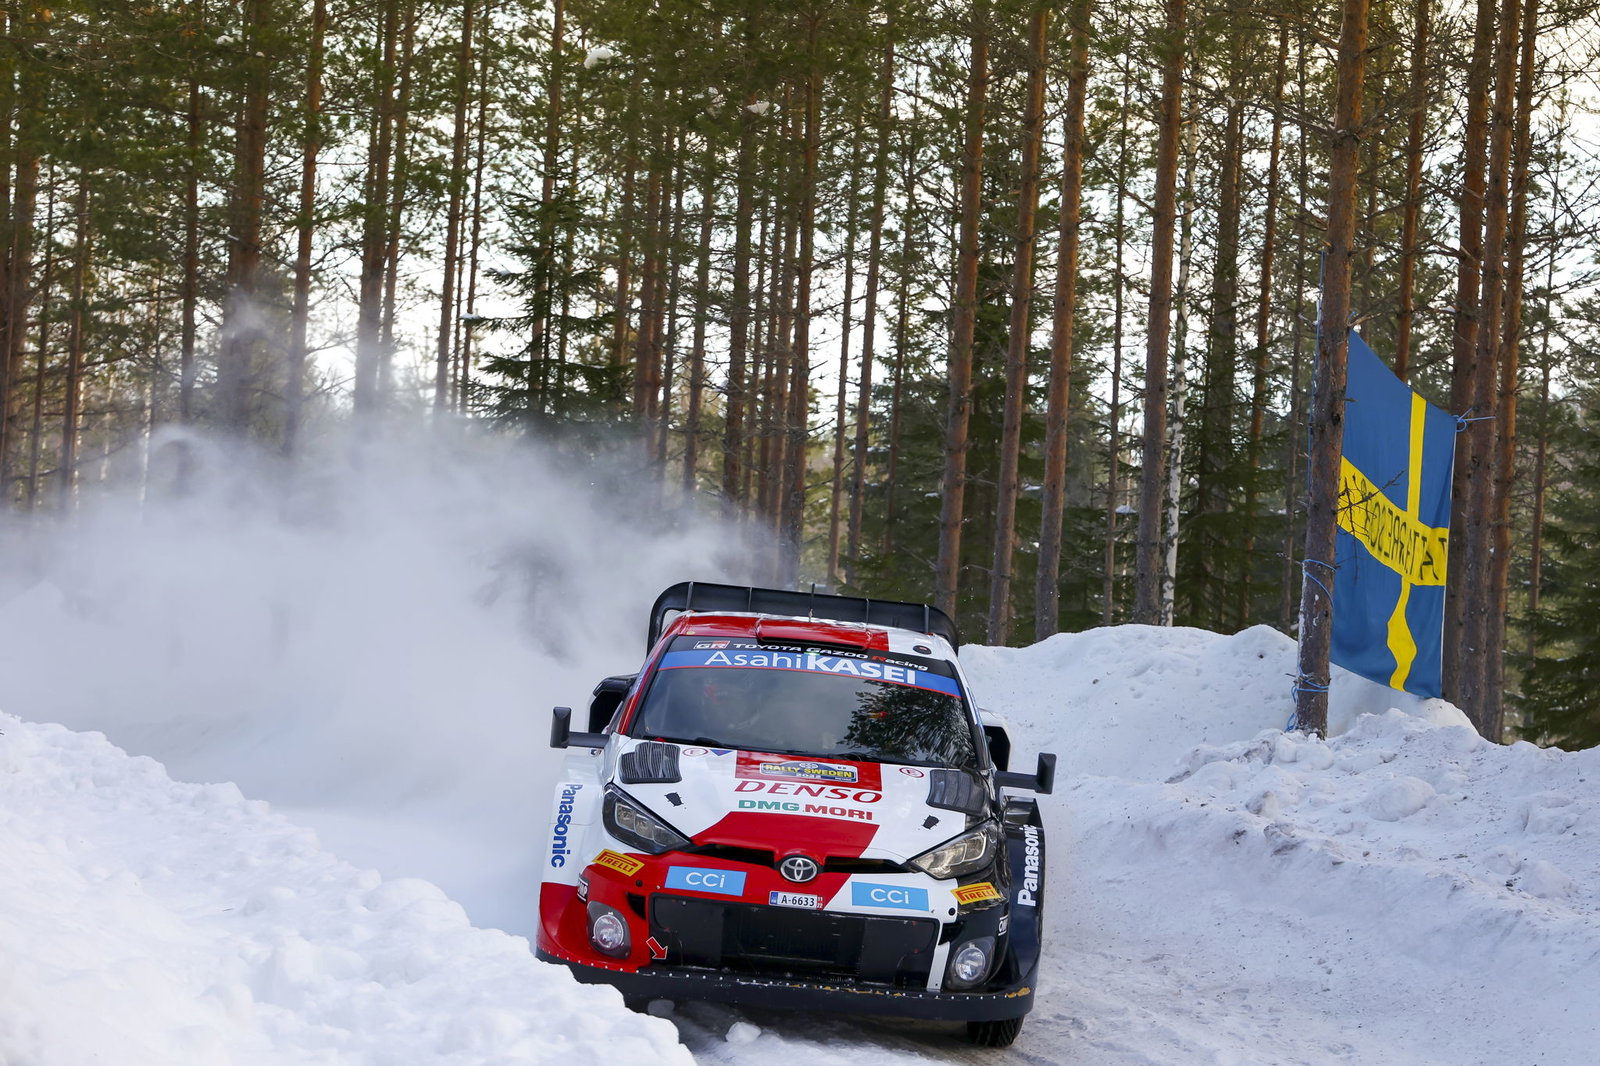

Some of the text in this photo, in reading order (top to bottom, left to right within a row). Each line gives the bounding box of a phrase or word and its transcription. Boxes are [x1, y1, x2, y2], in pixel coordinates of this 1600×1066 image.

[733, 643, 802, 652] TOYOTA
[805, 648, 869, 660] GAZOO
[872, 655, 929, 671] Racing
[764, 763, 853, 778] RALLY SWEDEN
[734, 780, 883, 804] DENSO
[738, 799, 873, 821] DMG MORI
[551, 784, 584, 869] Panasonic
[597, 851, 639, 873] PIRELLI
[781, 895, 815, 907] A-6633
[955, 885, 996, 902] PIRELLI
